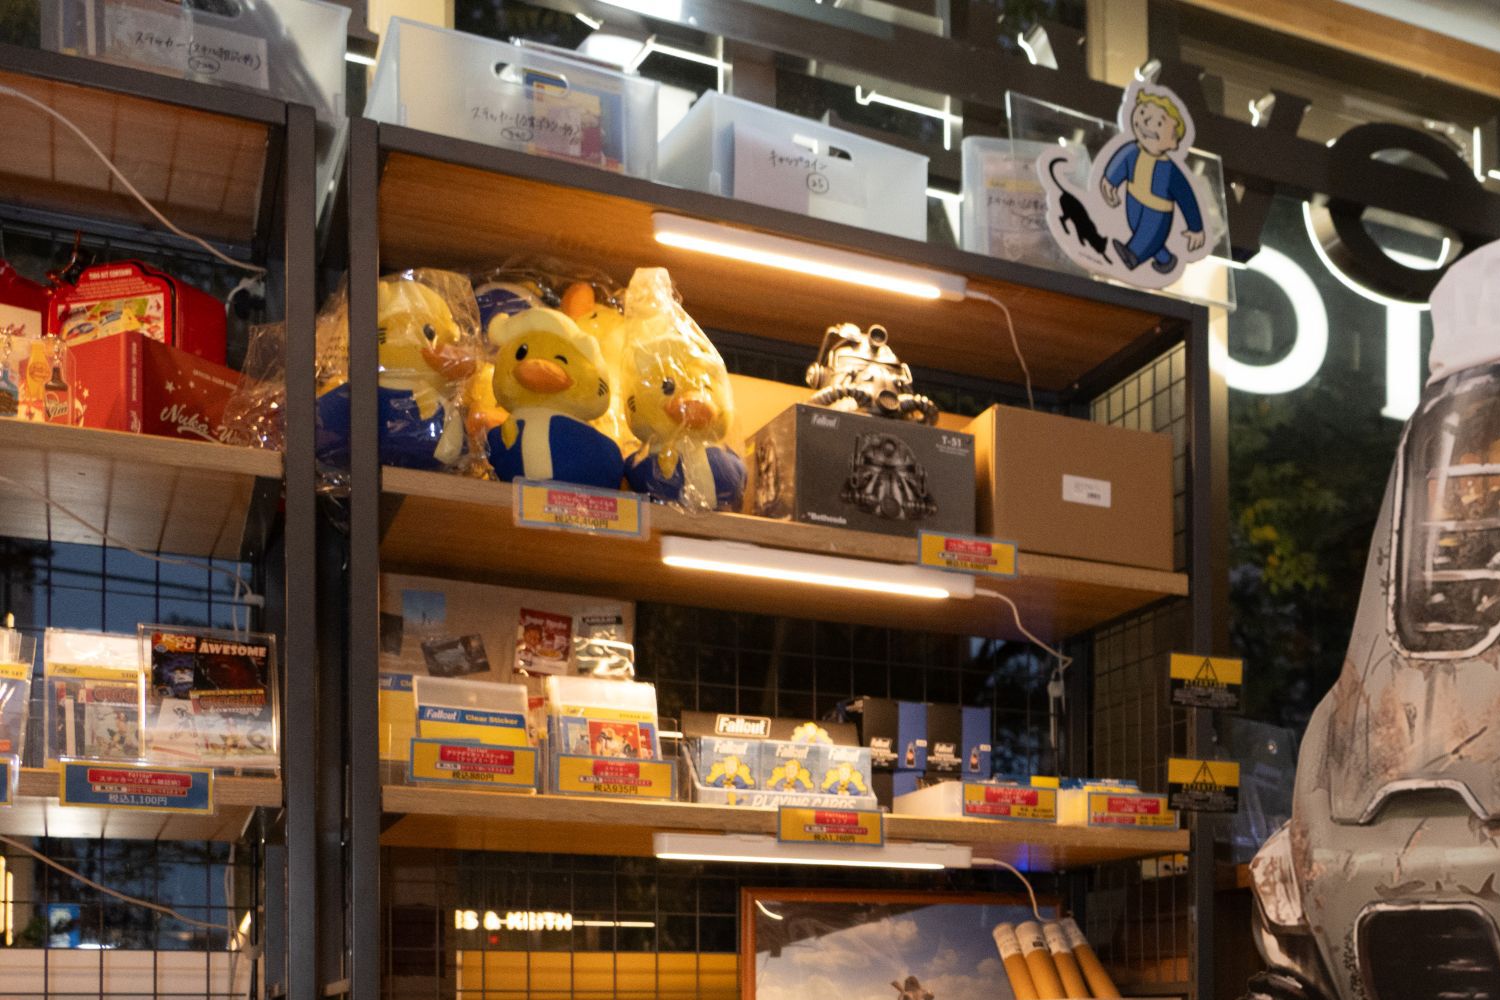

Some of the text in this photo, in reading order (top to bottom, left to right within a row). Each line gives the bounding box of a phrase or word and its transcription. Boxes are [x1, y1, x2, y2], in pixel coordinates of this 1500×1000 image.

[941, 435, 962, 447] T-51
[810, 512, 847, 525] Bethesda
[199, 641, 267, 658] AWESOME
[425, 707, 519, 726] Fallout Clear Sticker
[719, 717, 766, 735] Fallout
[713, 741, 748, 755] Fallout
[776, 744, 810, 759] Fallout
[828, 748, 861, 762] Fallout
[593, 783, 638, 795] 税込935円
[108, 794, 168, 806] 税込1,100円
[752, 795, 857, 809] PLAYING CARDS
